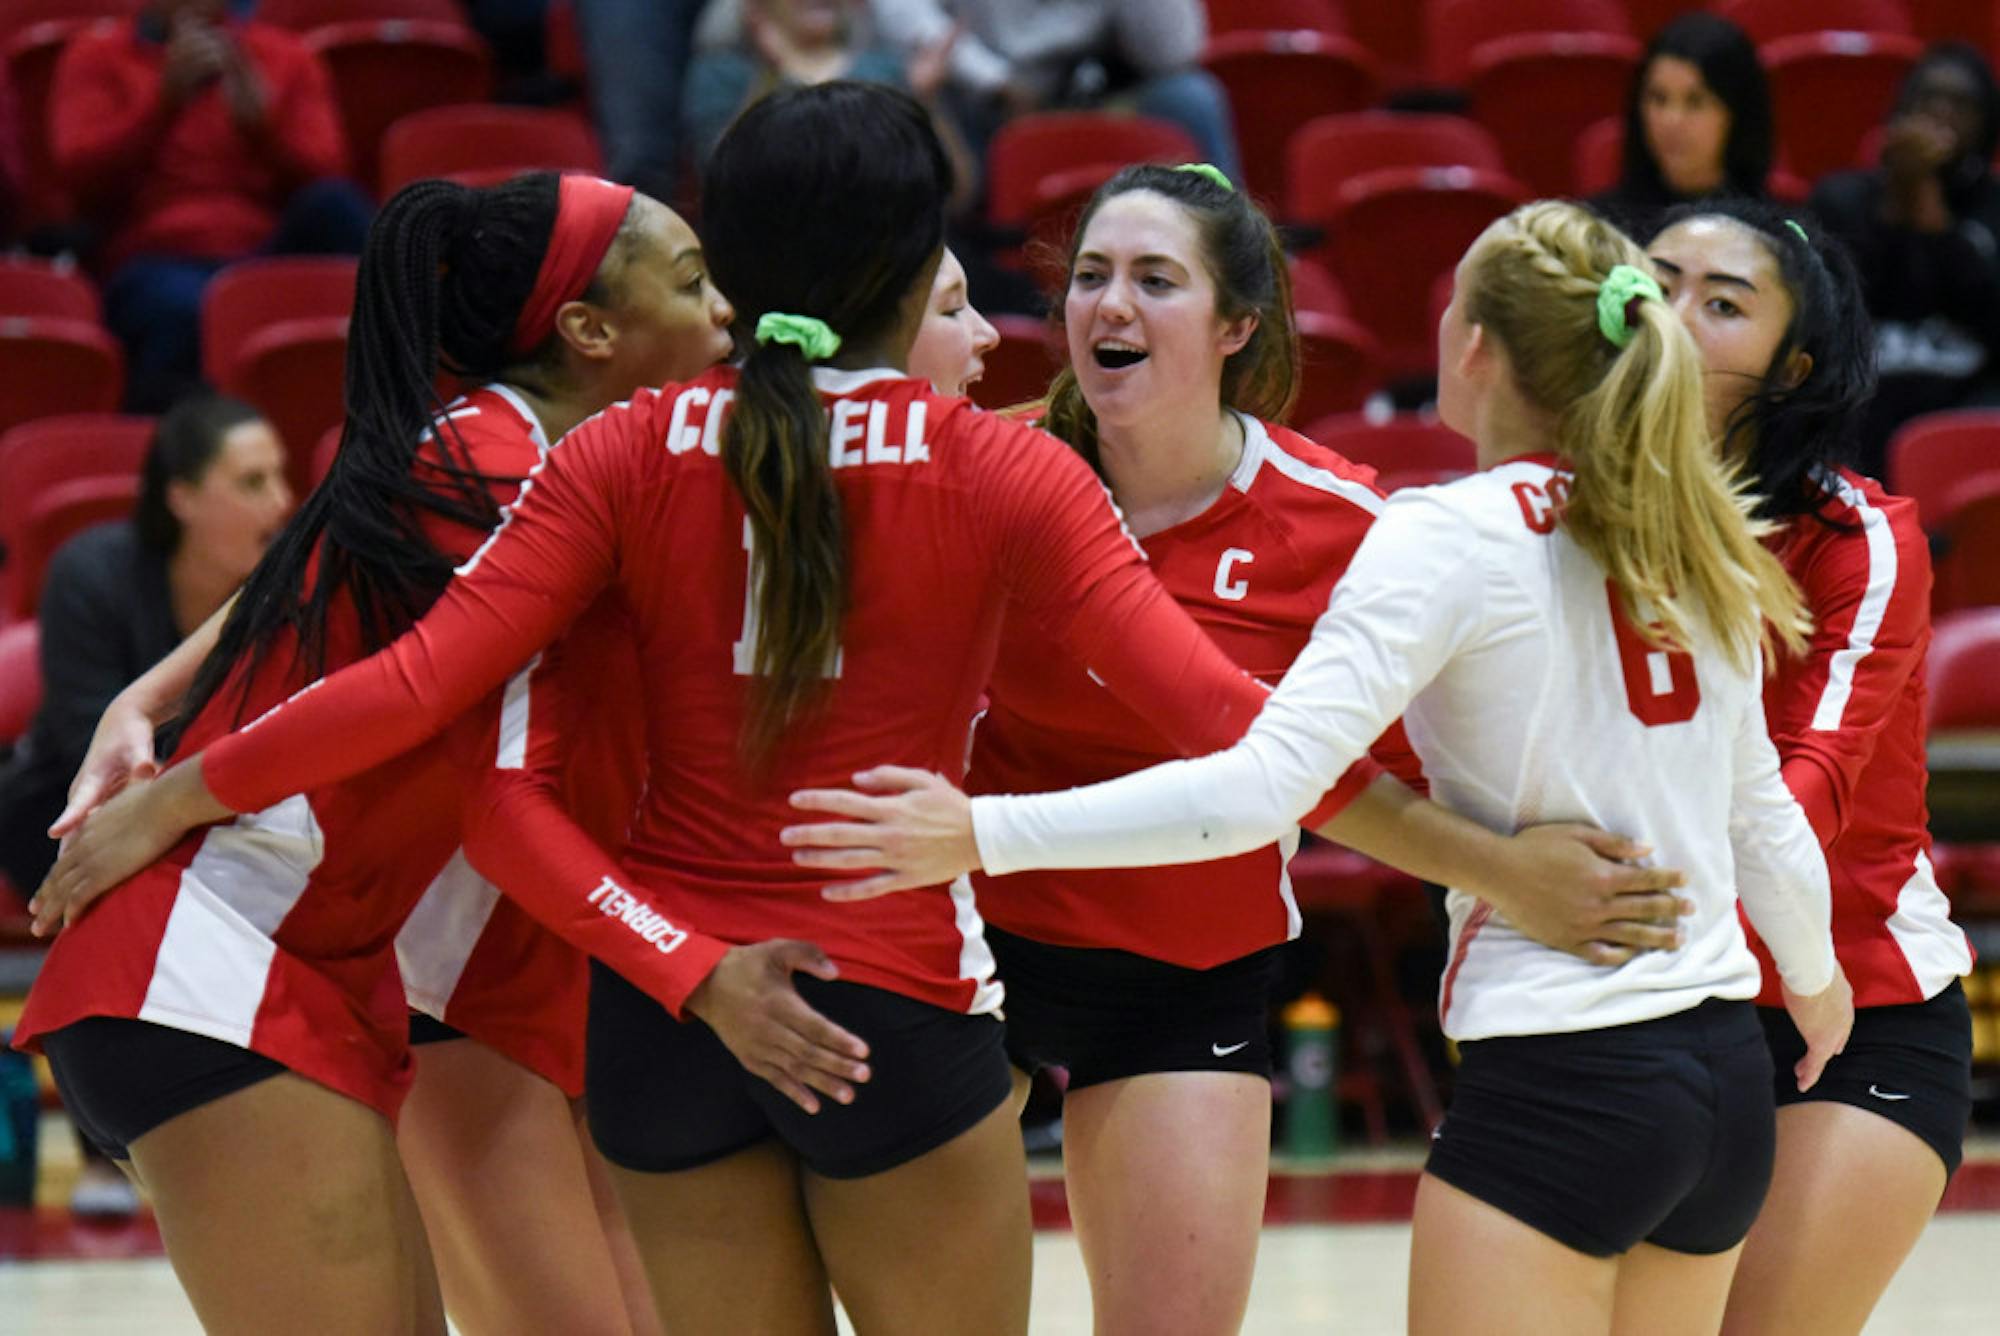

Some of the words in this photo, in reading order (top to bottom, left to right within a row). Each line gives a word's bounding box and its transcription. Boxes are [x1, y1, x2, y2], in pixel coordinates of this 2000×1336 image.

[667, 387, 930, 468] COELL
[1213, 547, 1255, 601] C
[586, 875, 689, 954] CORNELL
